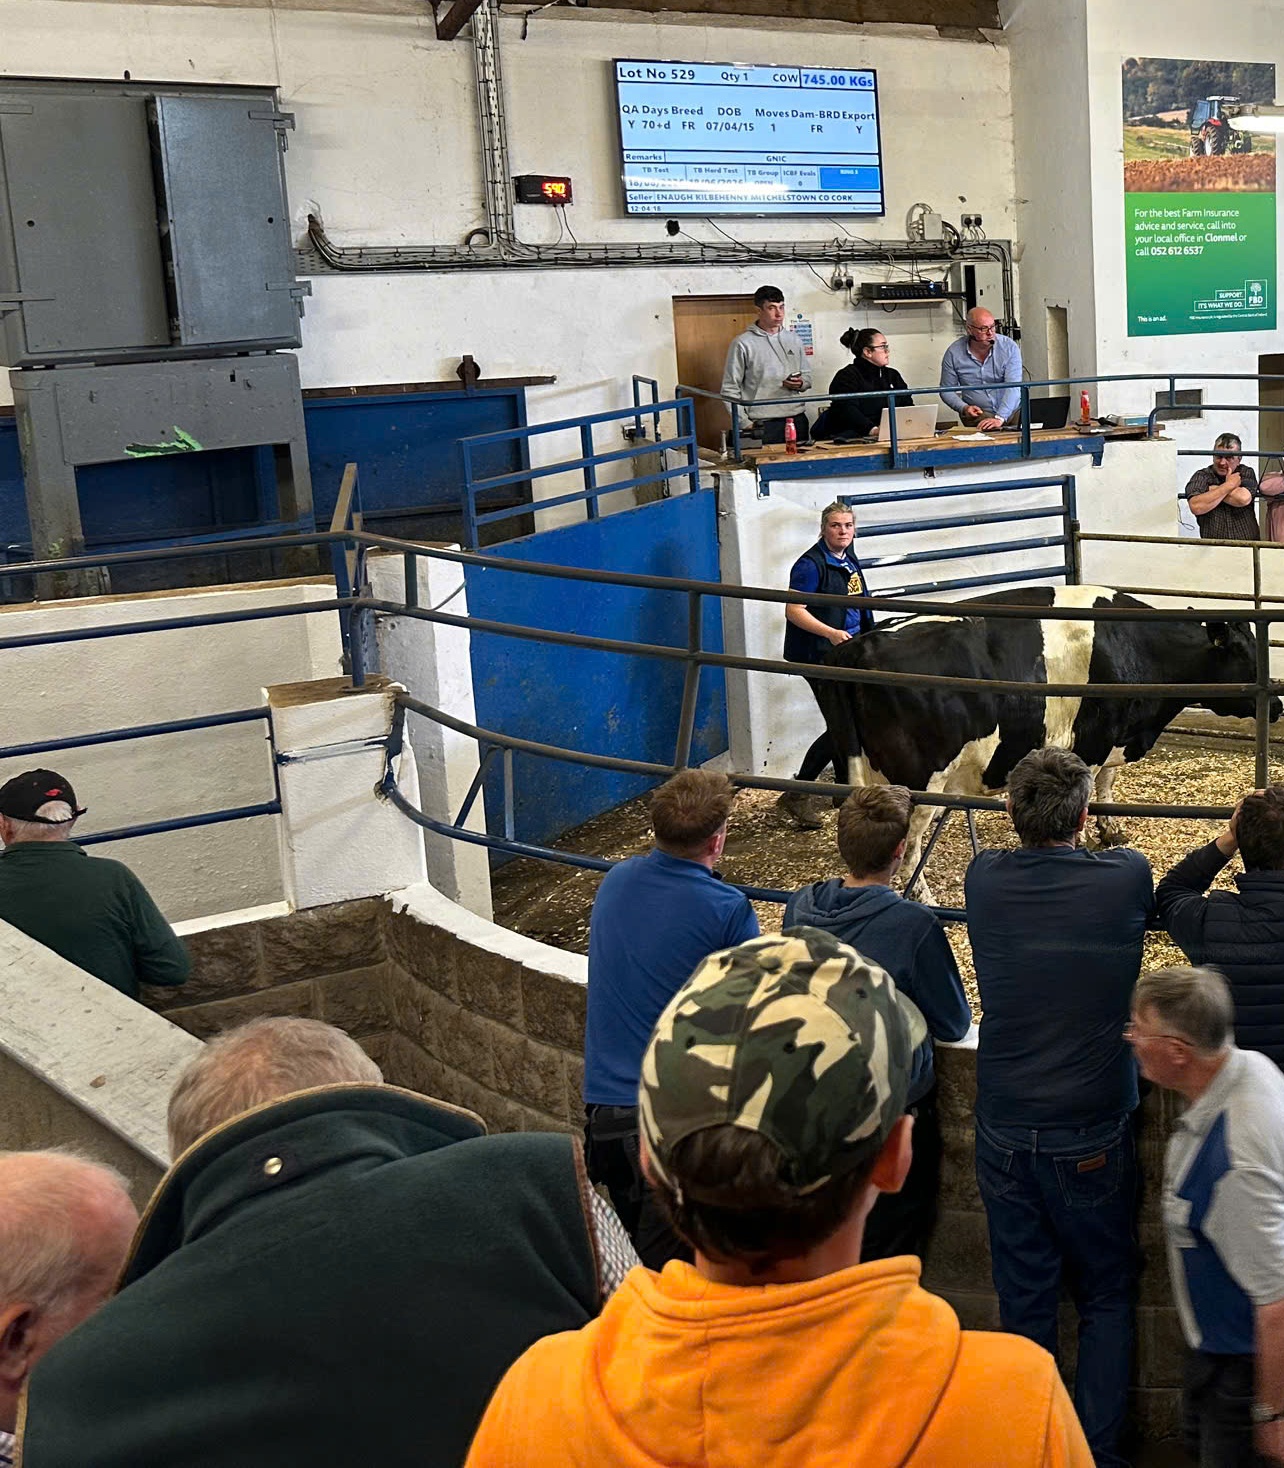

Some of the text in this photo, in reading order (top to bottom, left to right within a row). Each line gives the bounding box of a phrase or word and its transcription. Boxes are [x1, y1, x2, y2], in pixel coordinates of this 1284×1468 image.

[620, 67, 798, 82] Lot No 529 Qty 1 COW
[803, 74, 873, 87] 745.00 KGs
[622, 104, 875, 122] QA Days Breed DOB Moves Dam-BRD Export
[628, 120, 863, 134] Y 70+d FR 07/04/15 1 FR Y
[1134, 209, 1239, 218] For the best Farm Insurance
[1134, 221, 1236, 231] advice and service, call into
[1135, 235, 1152, 245] your
[1154, 234, 1173, 243] local
[1175, 234, 1195, 242] office
[1197, 234, 1203, 242] in
[1205, 233, 1238, 242] Clonmel
[1136, 246, 1203, 256] call 052 612 6537
[1249, 296, 1263, 304] FBD
